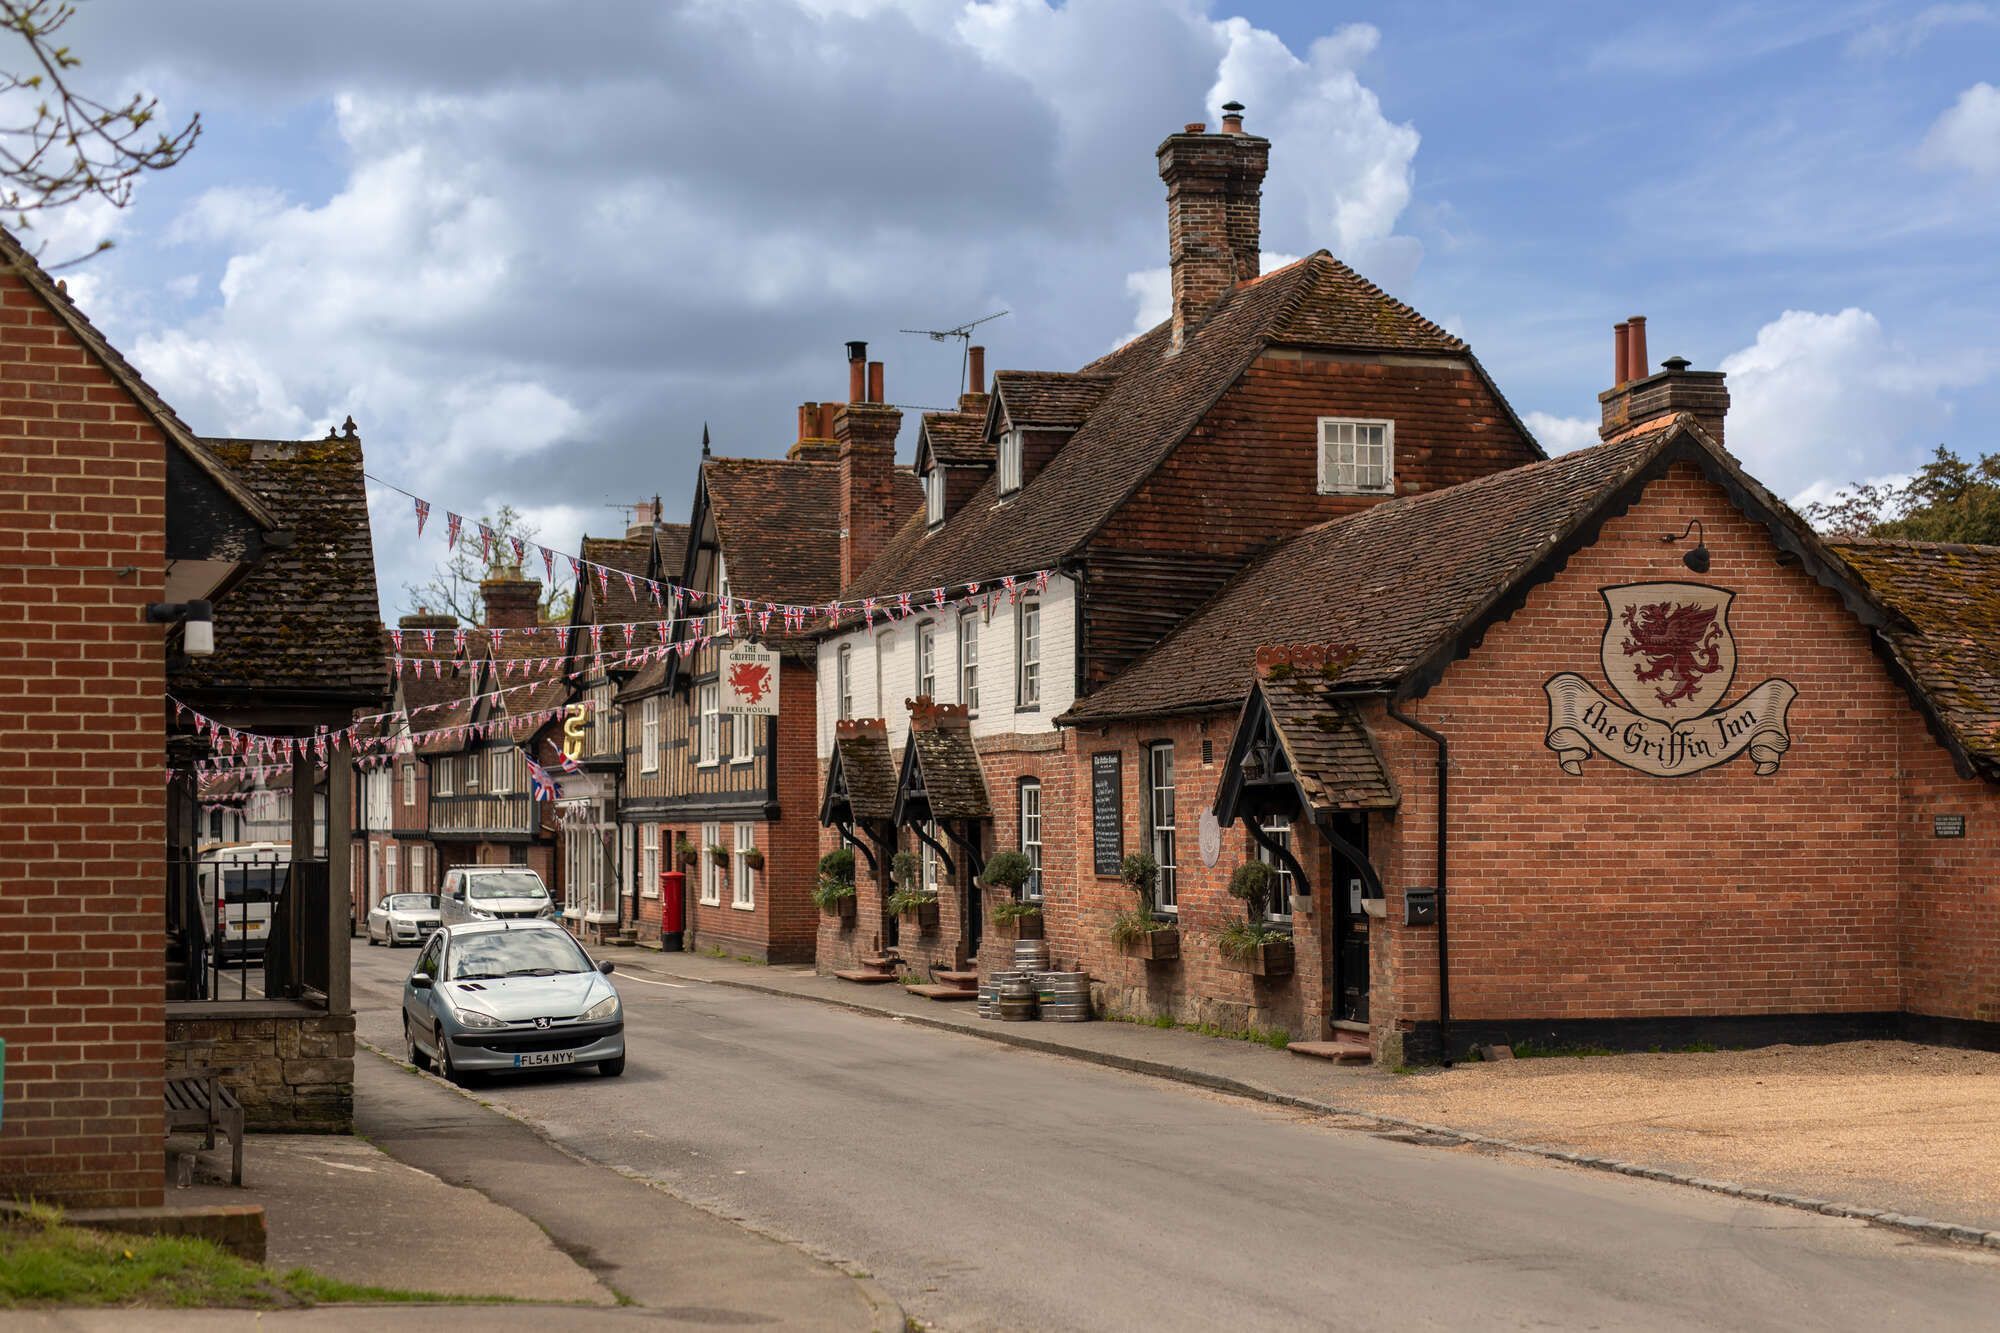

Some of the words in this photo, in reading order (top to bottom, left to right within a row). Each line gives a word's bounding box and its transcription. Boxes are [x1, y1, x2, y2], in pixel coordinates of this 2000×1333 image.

[744, 644, 757, 653] THE
[729, 653, 756, 661] GRIFFIN
[757, 653, 770, 662] INN
[726, 705, 743, 713] FREE
[746, 706, 771, 714] HOUSE
[1623, 718, 1718, 770] Griffin
[1711, 711, 1758, 750] Inn
[521, 1054, 550, 1066] FL54
[552, 1051, 574, 1063] NYY
